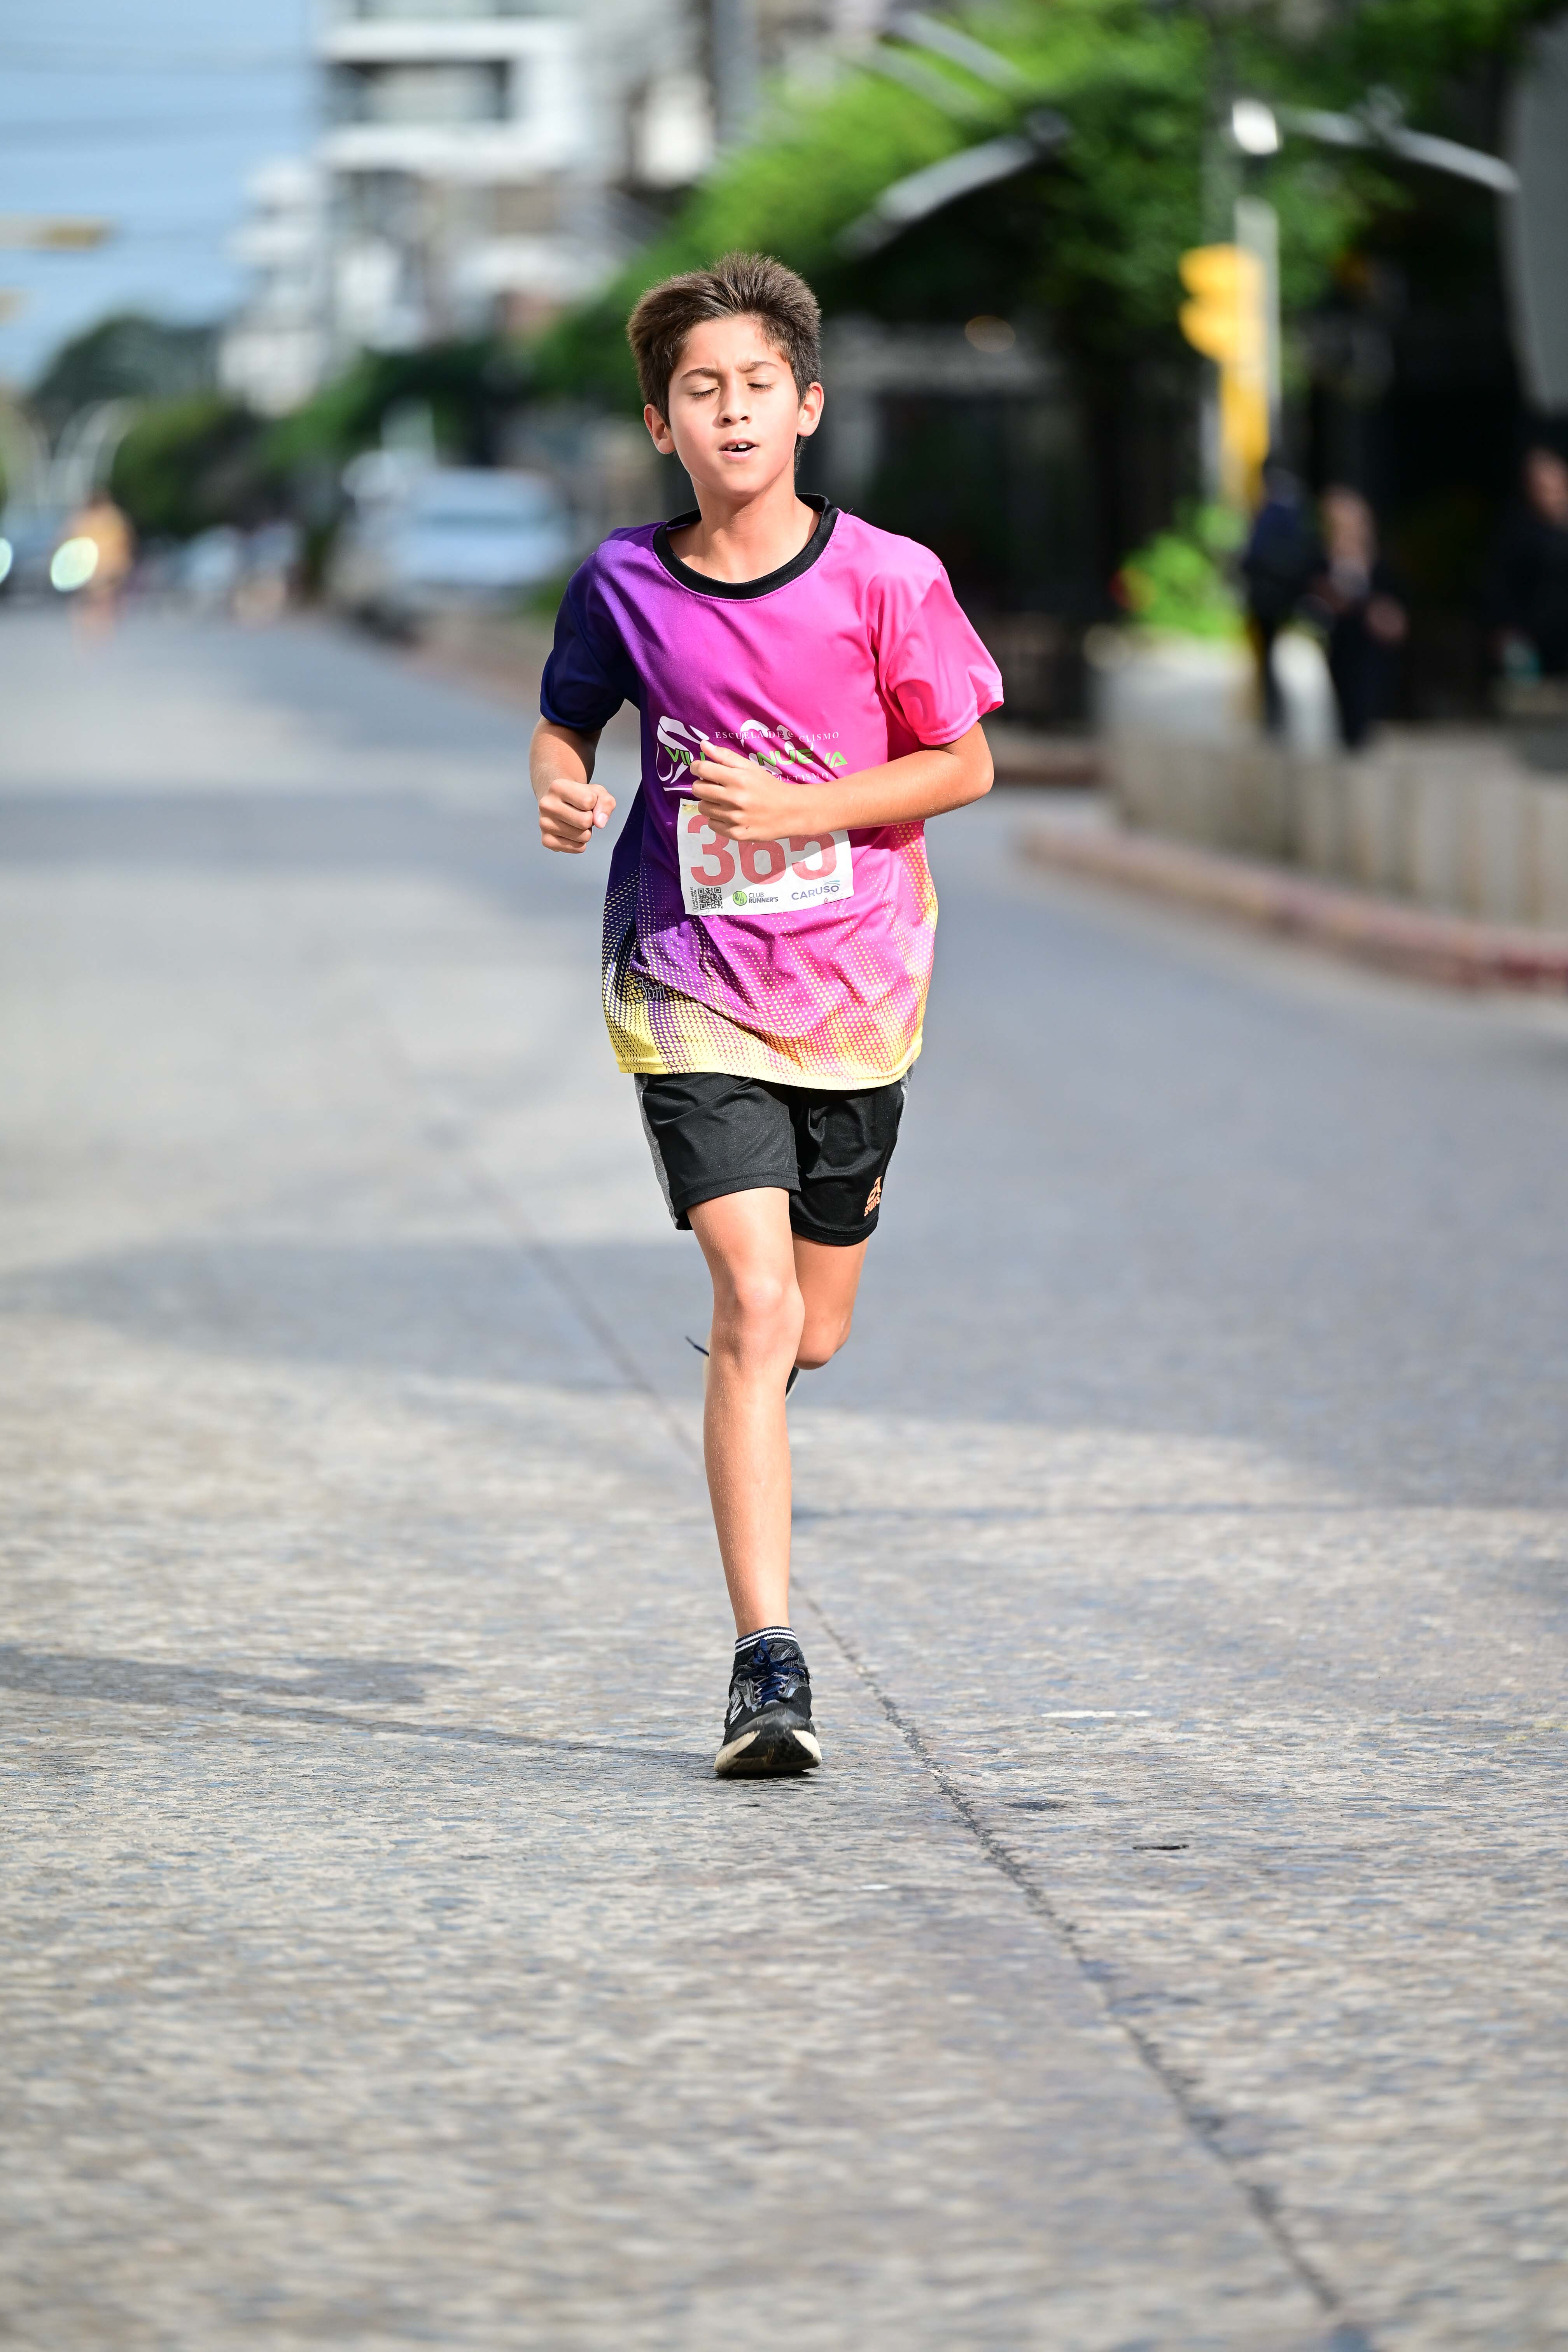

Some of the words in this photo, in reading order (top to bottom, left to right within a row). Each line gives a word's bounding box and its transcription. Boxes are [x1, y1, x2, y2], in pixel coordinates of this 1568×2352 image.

[715, 730, 765, 739] ESCUELA
[768, 730, 783, 738] DE
[787, 731, 839, 743] CCLISMO
[688, 814, 837, 886] 365
[791, 885, 839, 900] CARUSO
